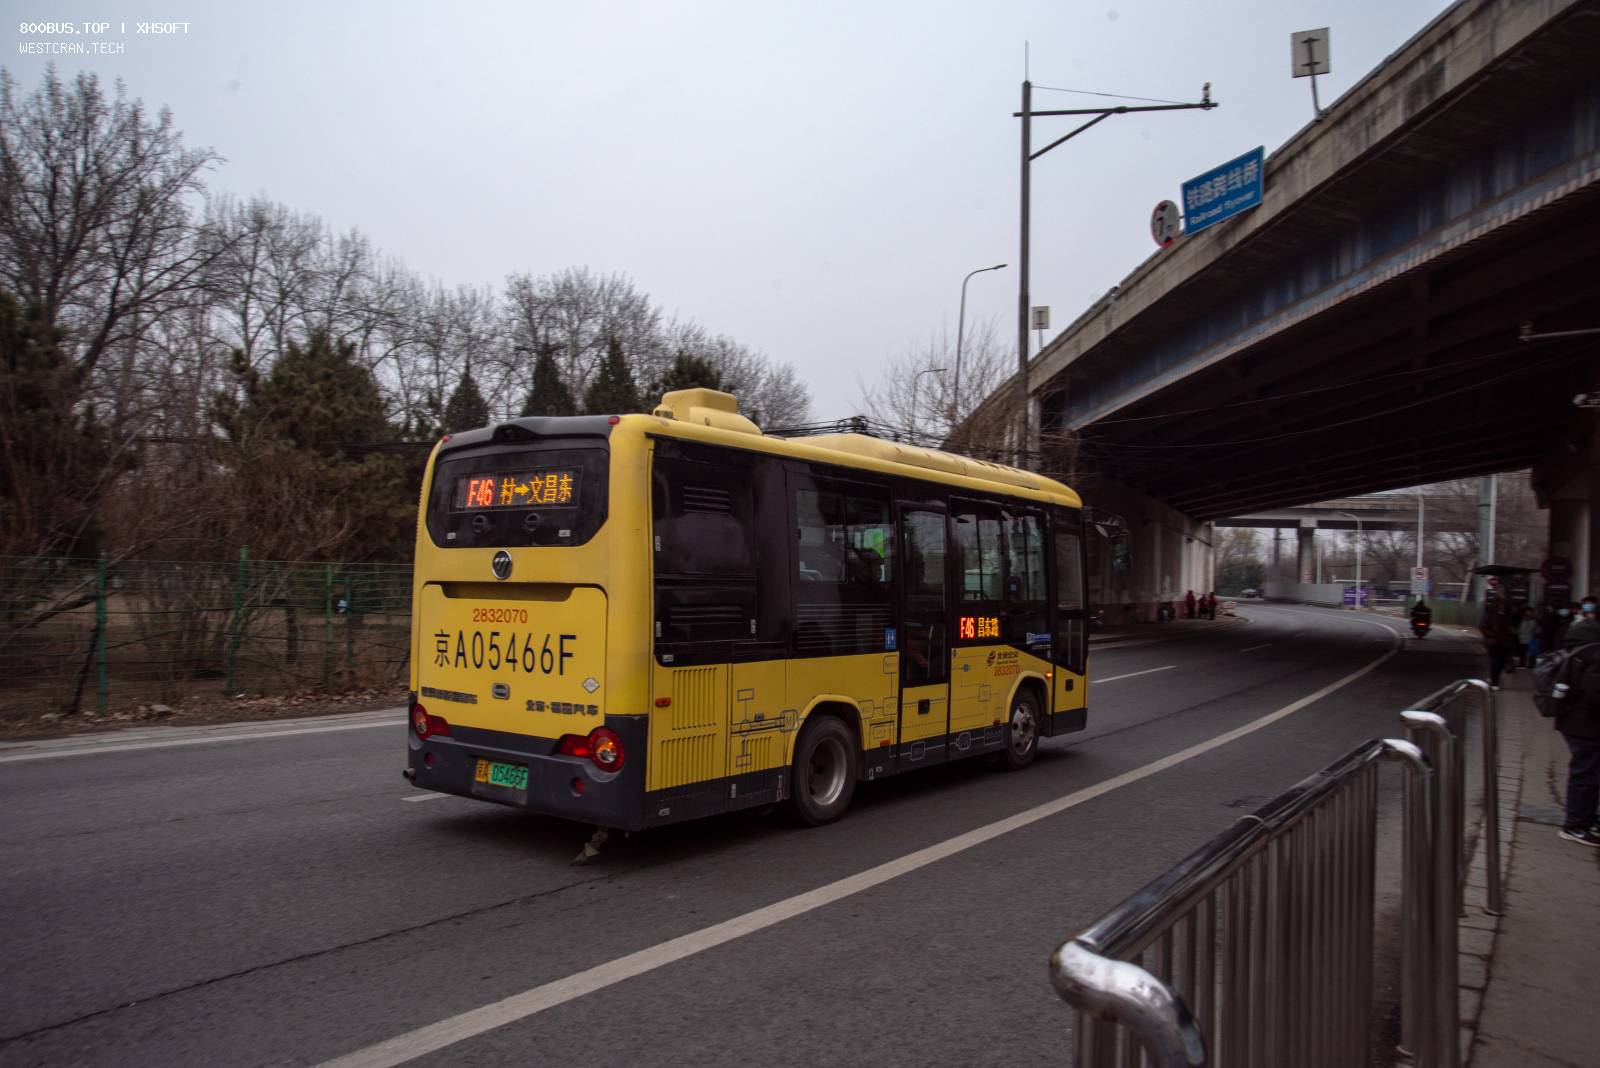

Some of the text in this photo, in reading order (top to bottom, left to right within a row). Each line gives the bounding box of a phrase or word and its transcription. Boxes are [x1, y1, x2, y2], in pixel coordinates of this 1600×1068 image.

[467, 479, 494, 507] F46
[472, 608, 528, 624] 2832070
[960, 618, 975, 638] F46
[433, 629, 577, 676] 京A05466F
